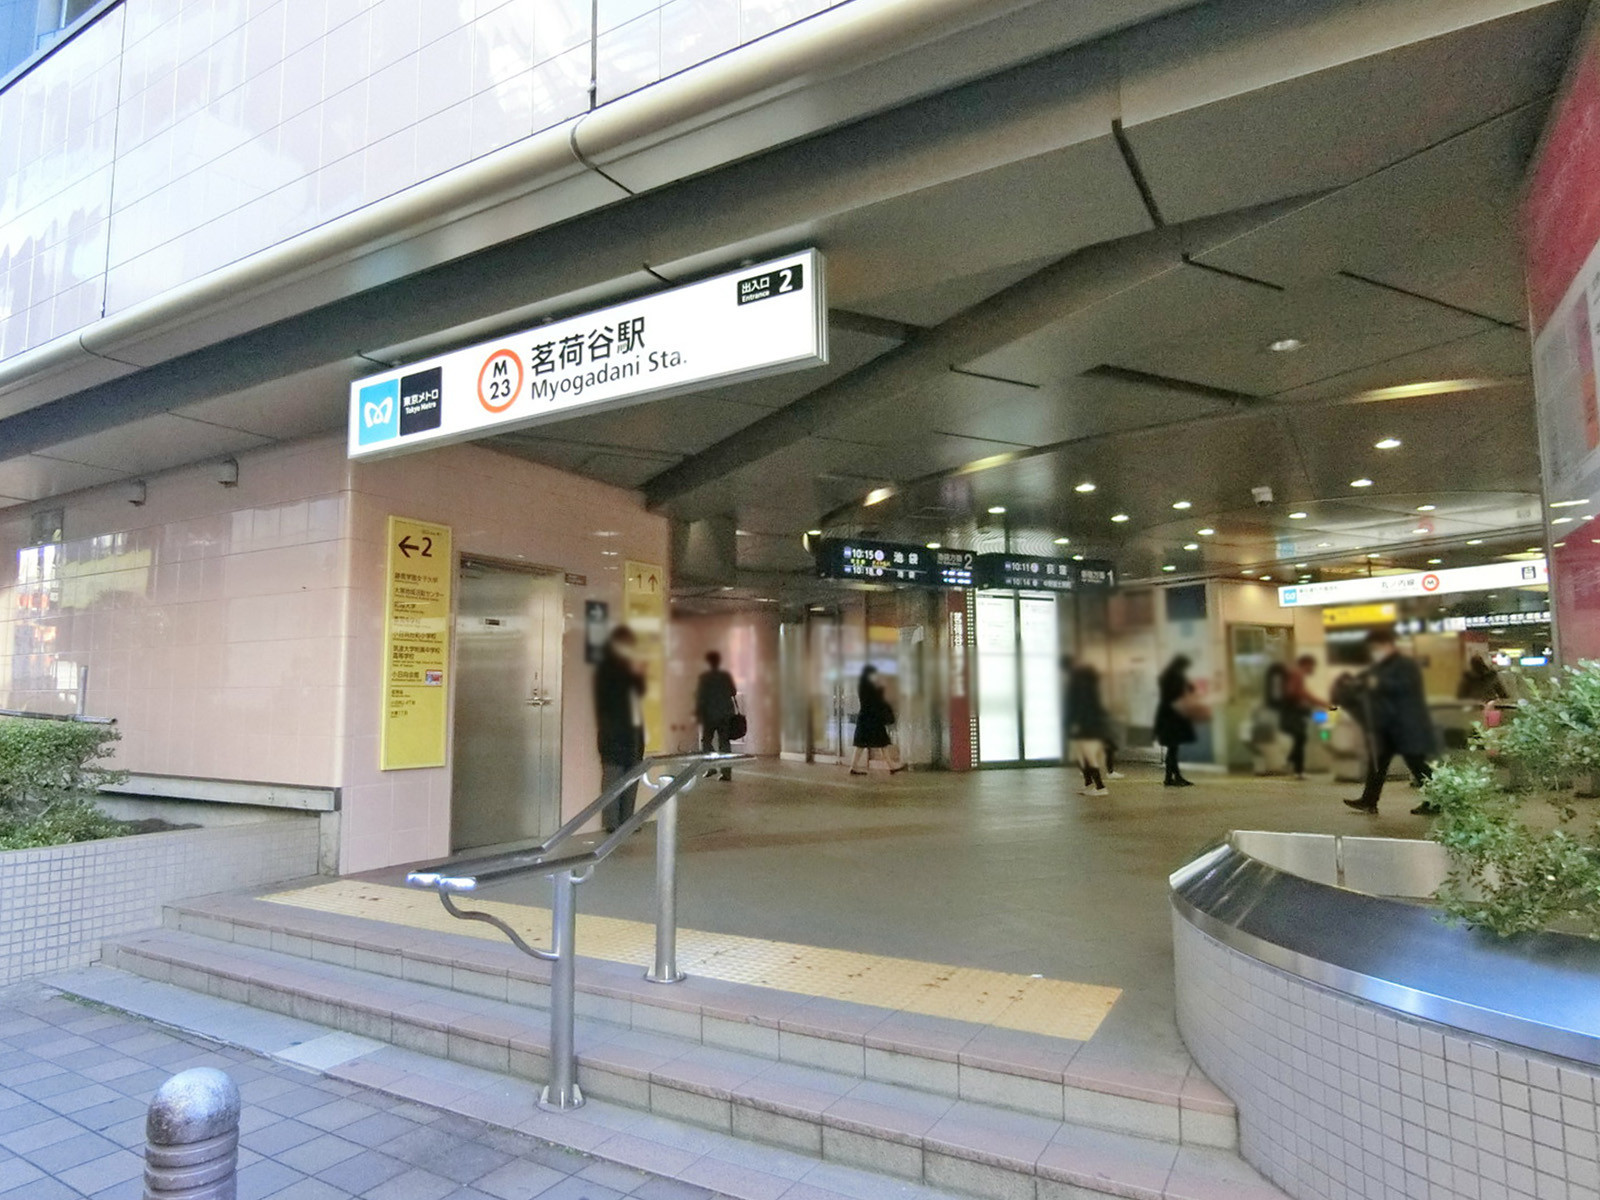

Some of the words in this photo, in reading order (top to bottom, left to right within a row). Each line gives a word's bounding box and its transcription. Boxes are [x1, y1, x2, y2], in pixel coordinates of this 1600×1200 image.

[741, 276, 770, 294] 出入口
[779, 269, 793, 293] 2
[741, 290, 770, 303] Entrance
[531, 316, 646, 377] 茗荷谷駅
[493, 360, 508, 378] M
[531, 355, 641, 402] Myogadani
[648, 350, 688, 373] Sta.
[403, 388, 439, 407] 東京メトロ
[489, 379, 511, 400] 23
[405, 405, 420, 415] Tokyo
[420, 401, 437, 412] Metro
[421, 536, 433, 558] 2
[852, 548, 874, 560] 10:15
[964, 553, 974, 570] 2
[1012, 563, 1030, 572] 10:11
[637, 574, 642, 589] 1
[1106, 569, 1114, 587] 1
